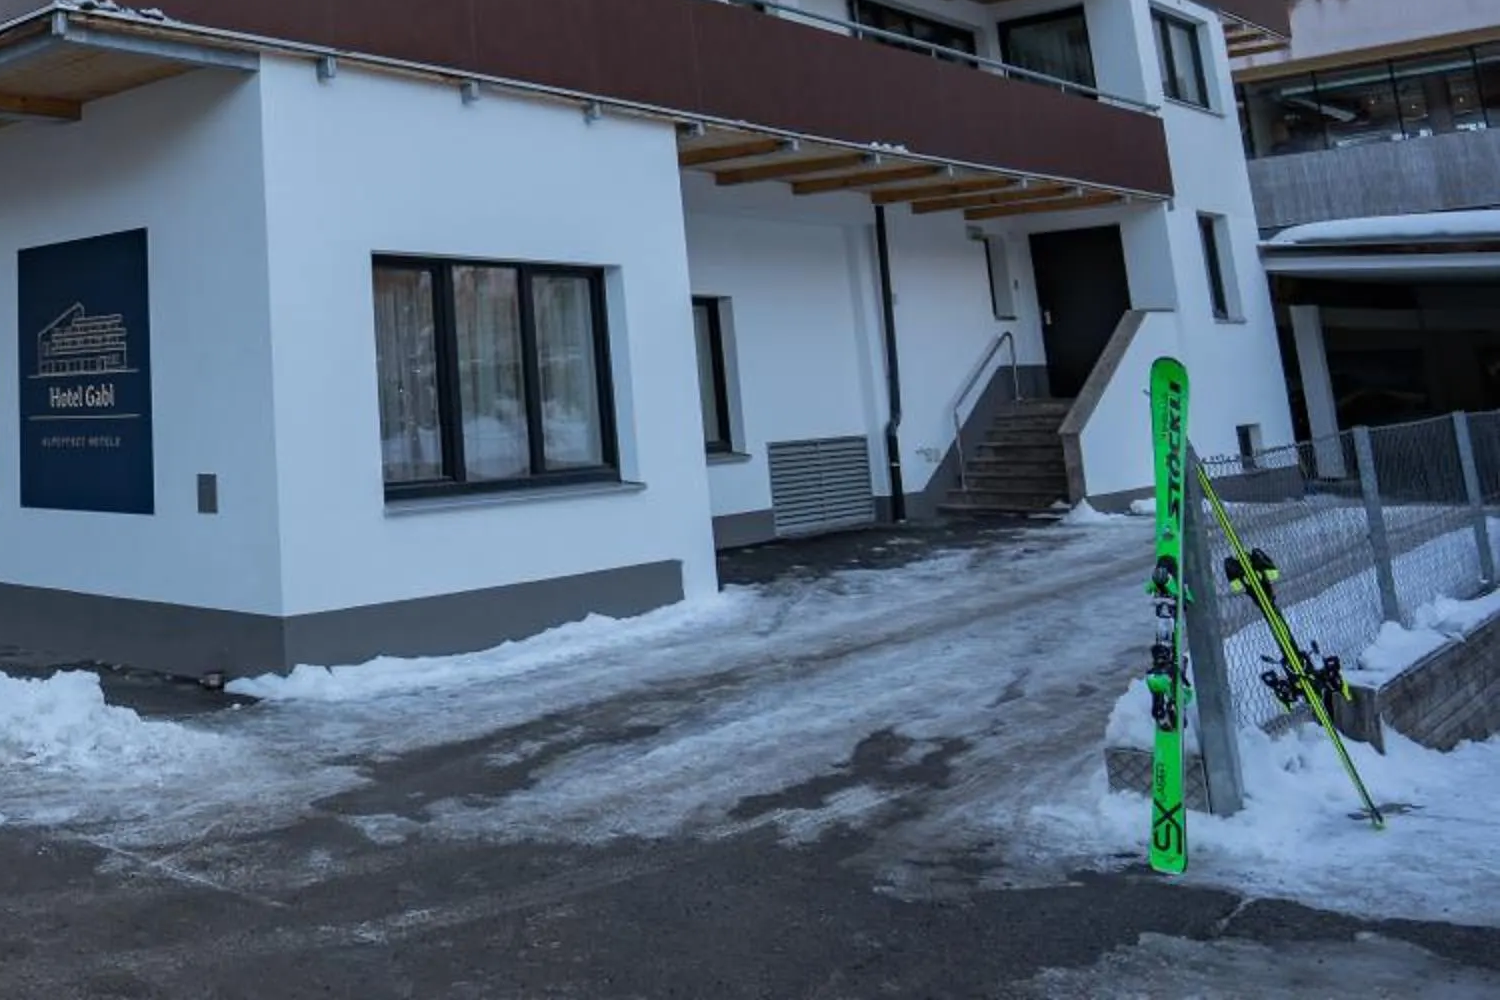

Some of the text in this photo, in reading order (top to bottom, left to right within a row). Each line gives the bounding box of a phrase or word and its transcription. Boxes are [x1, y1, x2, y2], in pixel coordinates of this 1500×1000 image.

[48, 382, 115, 408] Hotel Gabl
[1153, 798, 1182, 856] SX
